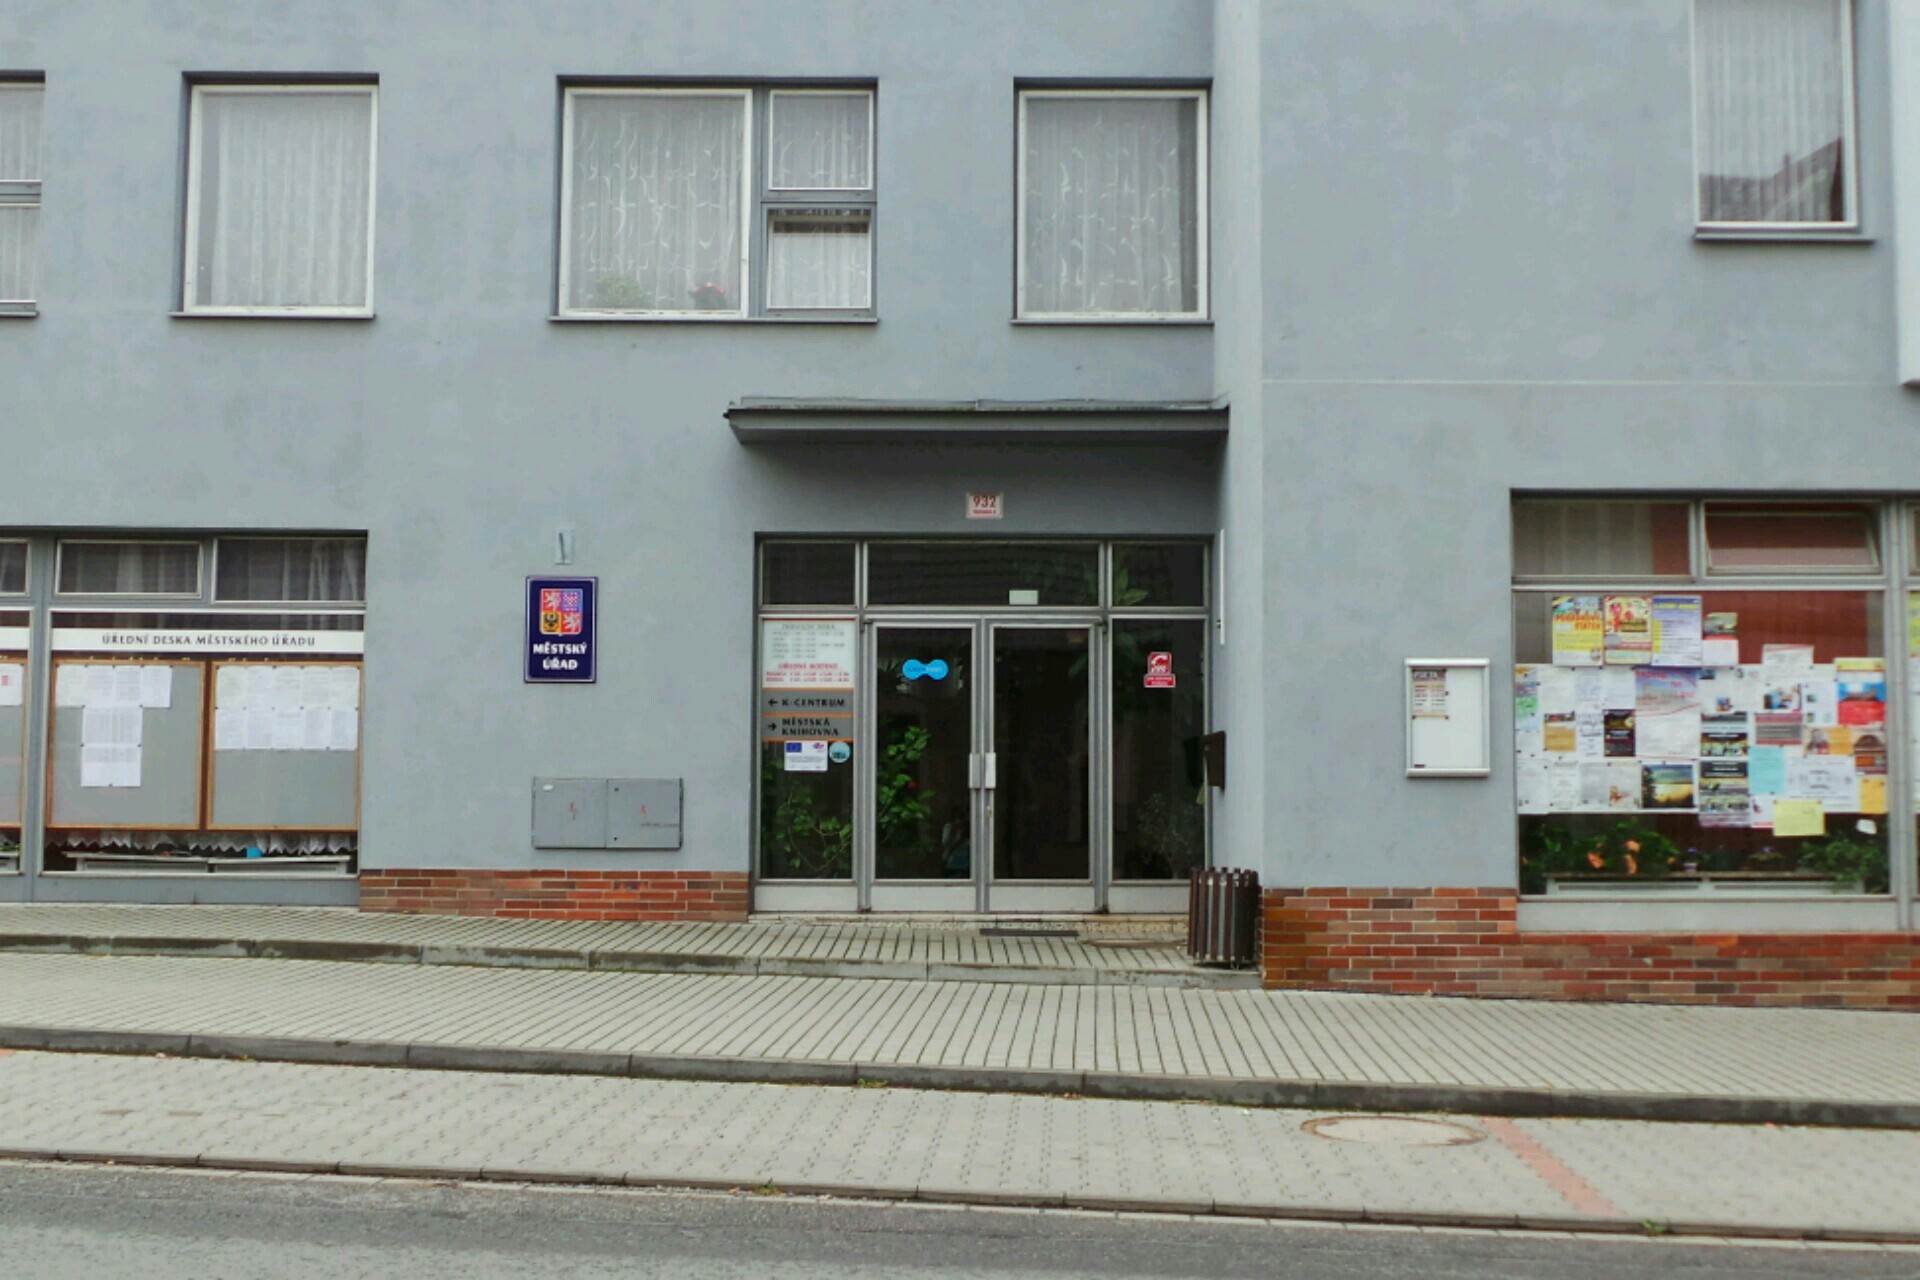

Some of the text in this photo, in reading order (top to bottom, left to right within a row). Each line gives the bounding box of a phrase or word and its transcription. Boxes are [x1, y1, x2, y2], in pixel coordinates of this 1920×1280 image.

[973, 495, 996, 508] 932
[102, 633, 315, 646] ÚŘEDNÍ DESKA MĚSTSKÉHO ÚŘADU
[533, 641, 587, 655] MĚSTSKÝ
[542, 656, 578, 670] ÚŘAD
[782, 716, 831, 727] MĚSTSKÁ
[781, 728, 840, 737] KNIHOVNA
